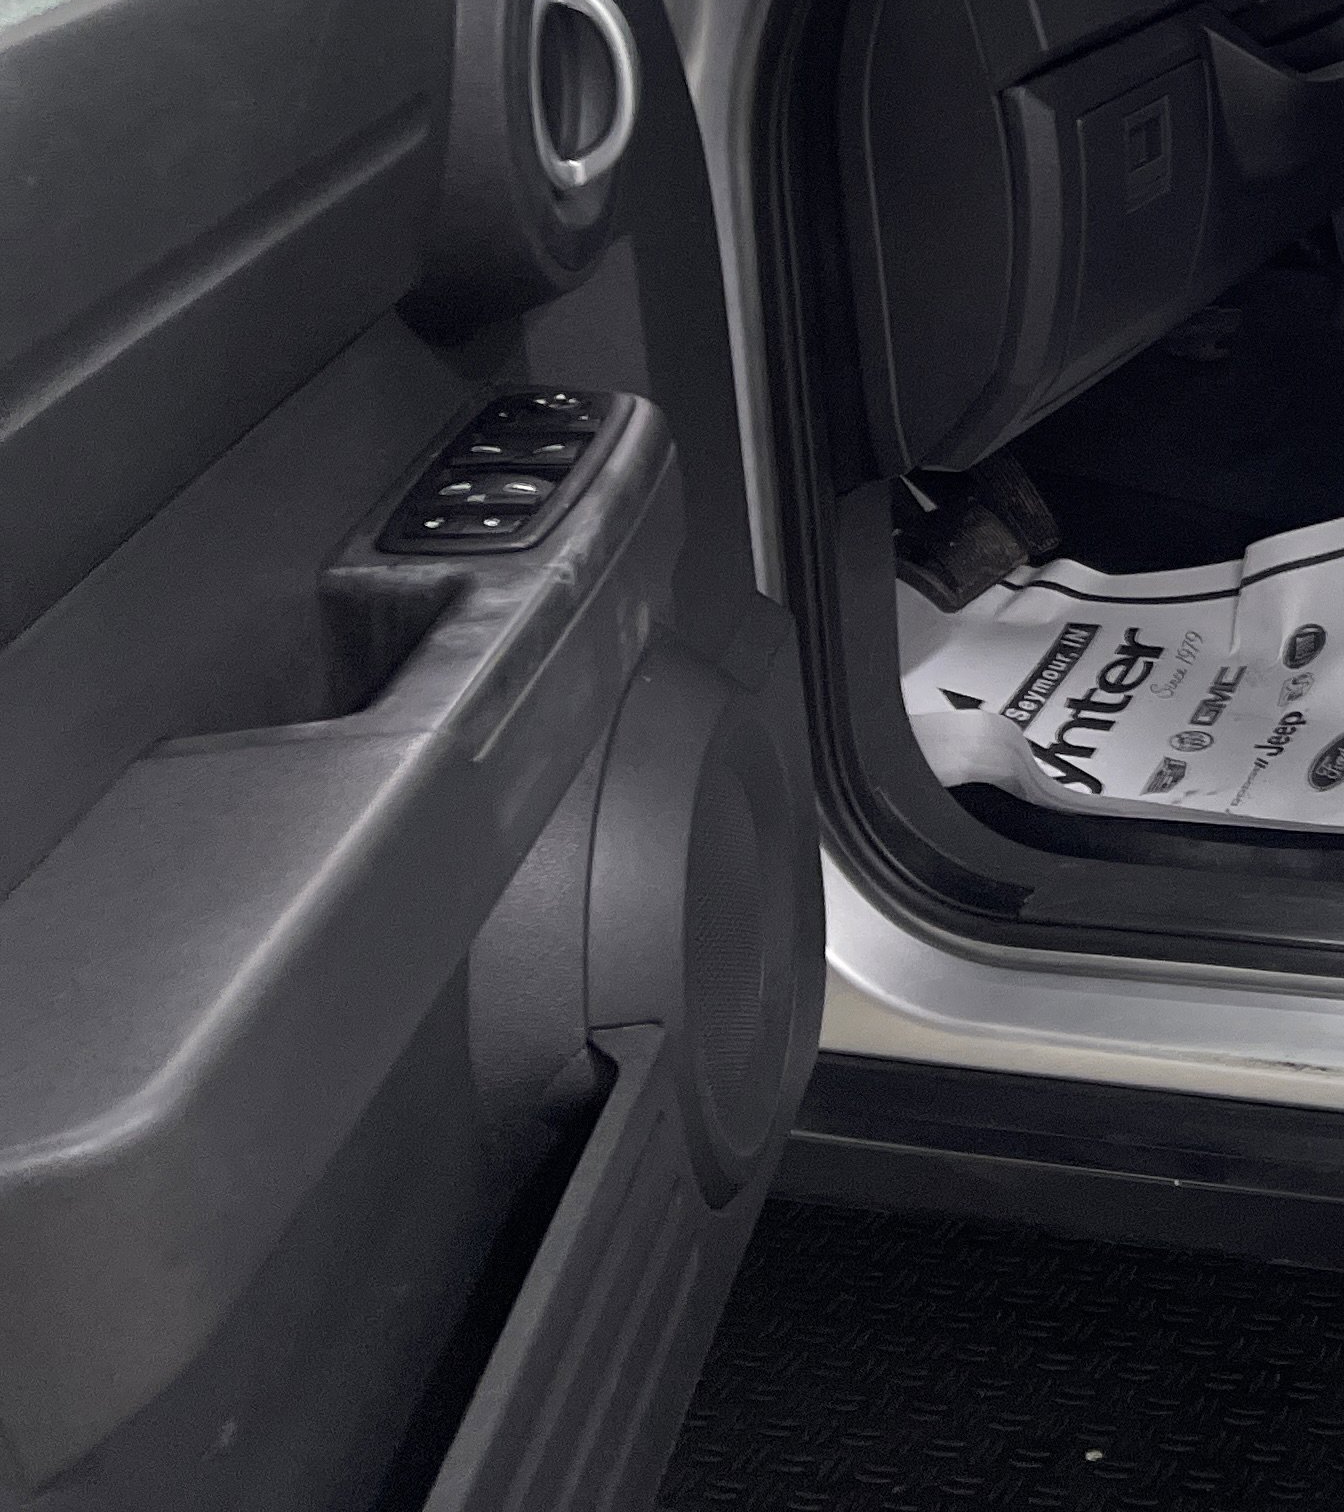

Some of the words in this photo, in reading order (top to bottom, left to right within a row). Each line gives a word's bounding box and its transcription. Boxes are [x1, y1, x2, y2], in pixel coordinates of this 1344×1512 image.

[1005, 650, 1079, 721] Seymour,
[1061, 626, 1090, 650] IN
[1175, 630, 1205, 667] 1979
[1188, 664, 1248, 727] GMC
[1253, 710, 1308, 757] Jeep
